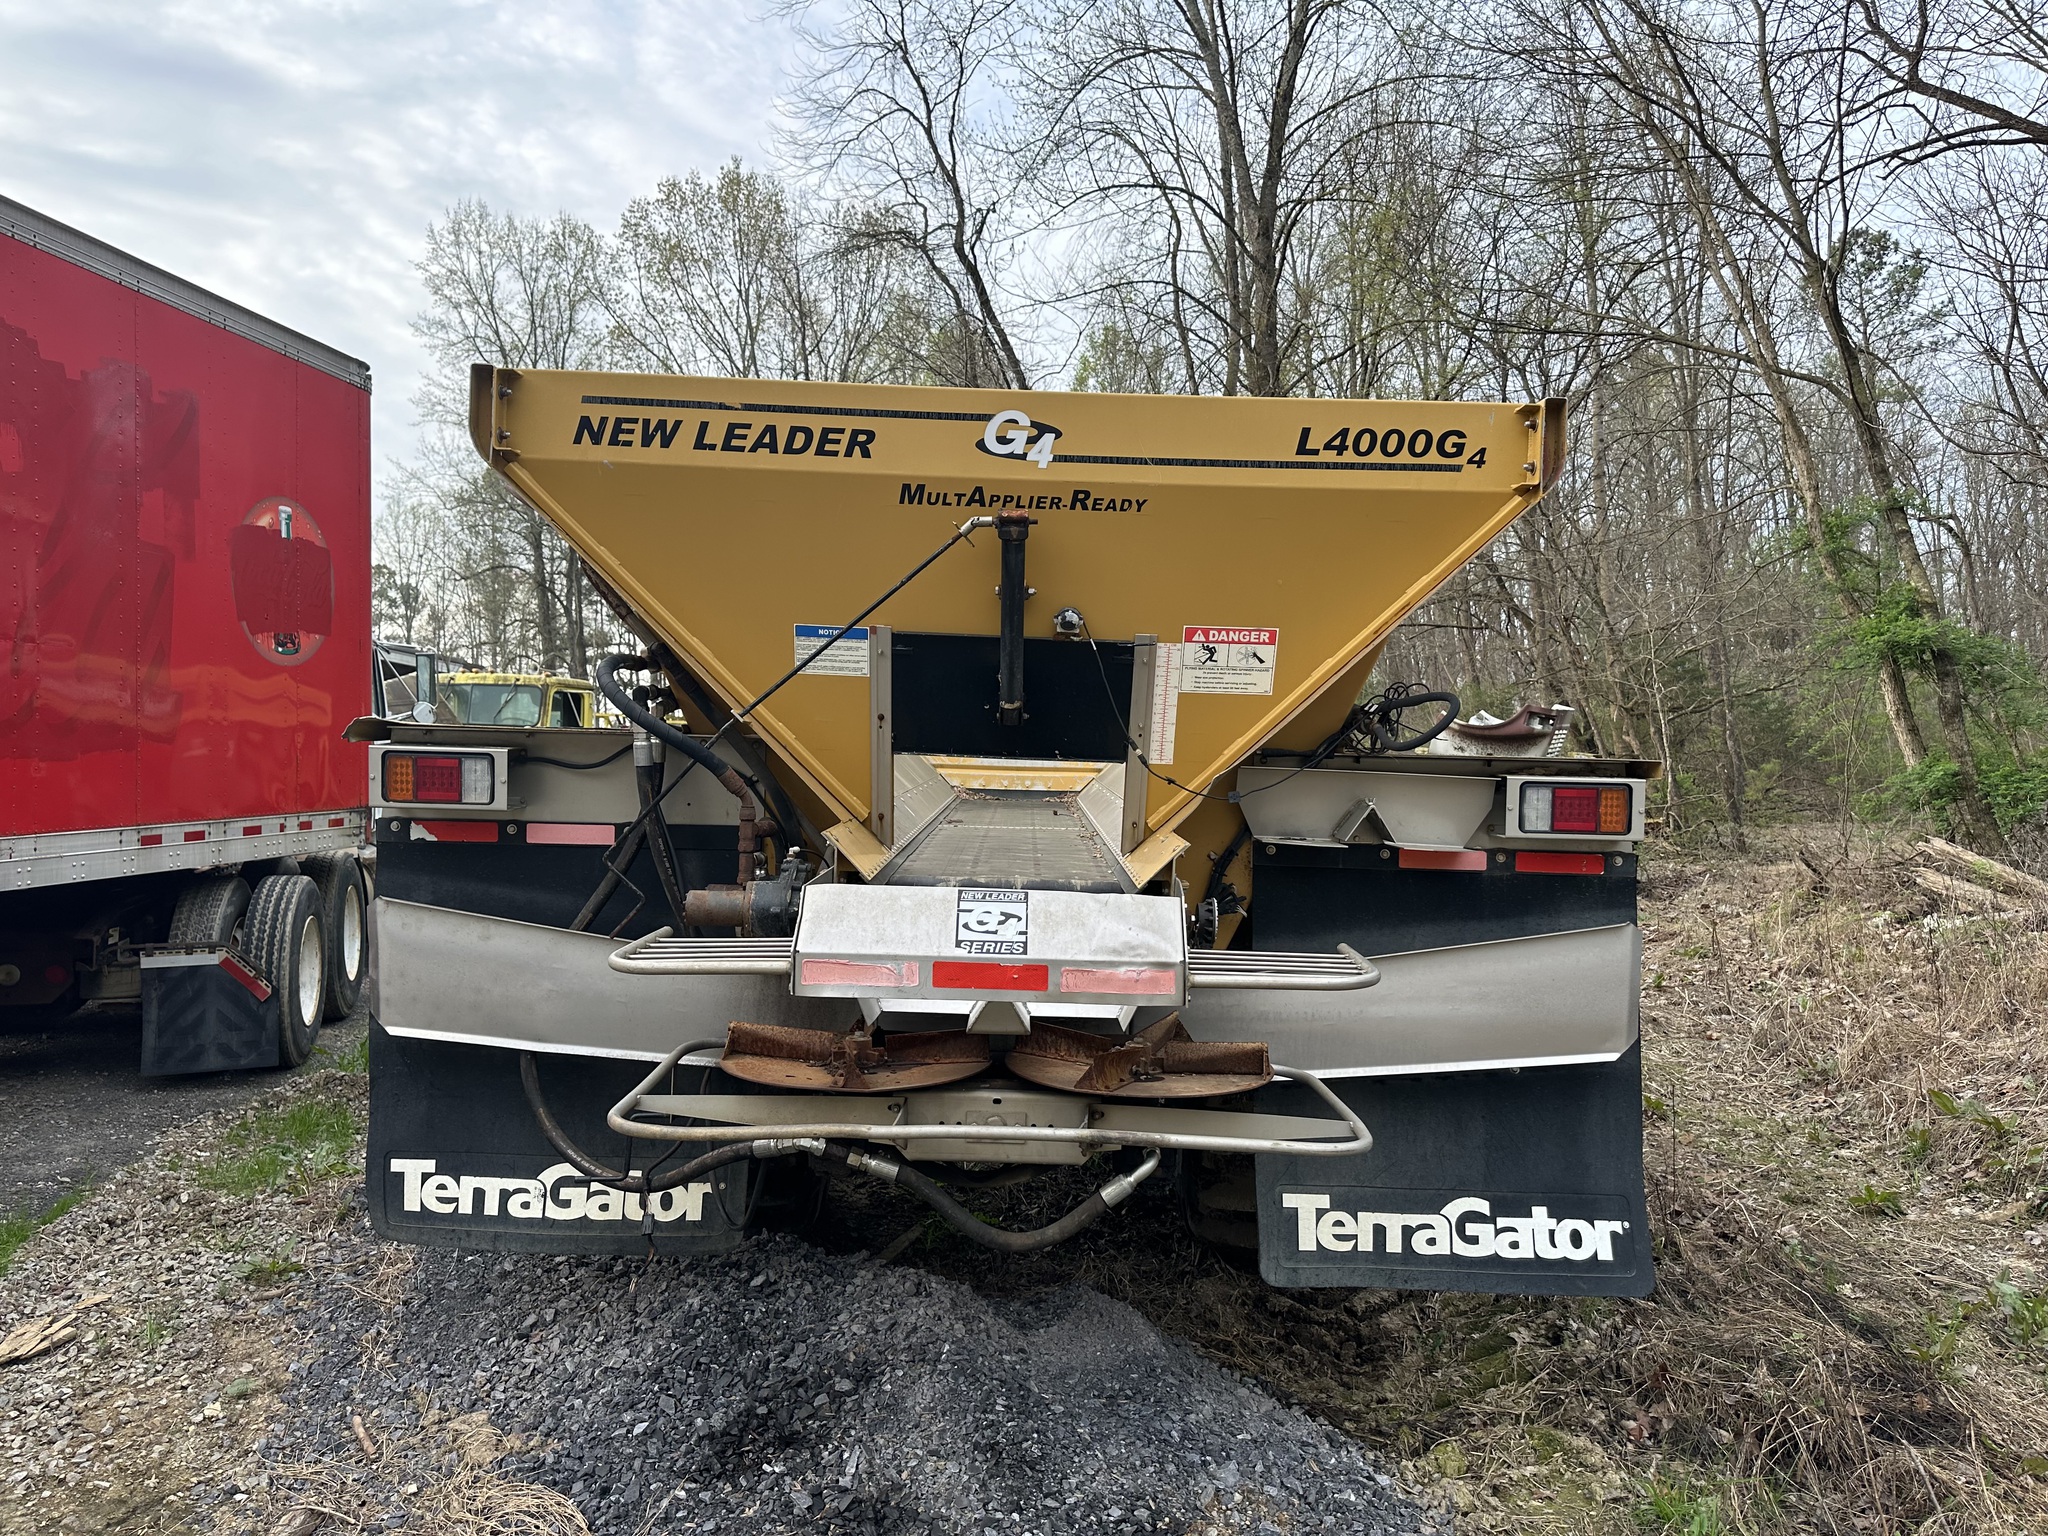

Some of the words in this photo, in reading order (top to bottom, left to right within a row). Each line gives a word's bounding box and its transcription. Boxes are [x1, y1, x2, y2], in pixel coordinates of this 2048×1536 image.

[573, 415, 684, 449] NEW
[692, 420, 877, 460] LEADER
[1208, 630, 1270, 643] DANGER
[960, 891, 984, 901] NEW
[985, 892, 1026, 901] LEADER
[960, 941, 1025, 954] SERIES
[390, 1157, 714, 1223] TerraGator
[1282, 1193, 1623, 1262] TerraGator
